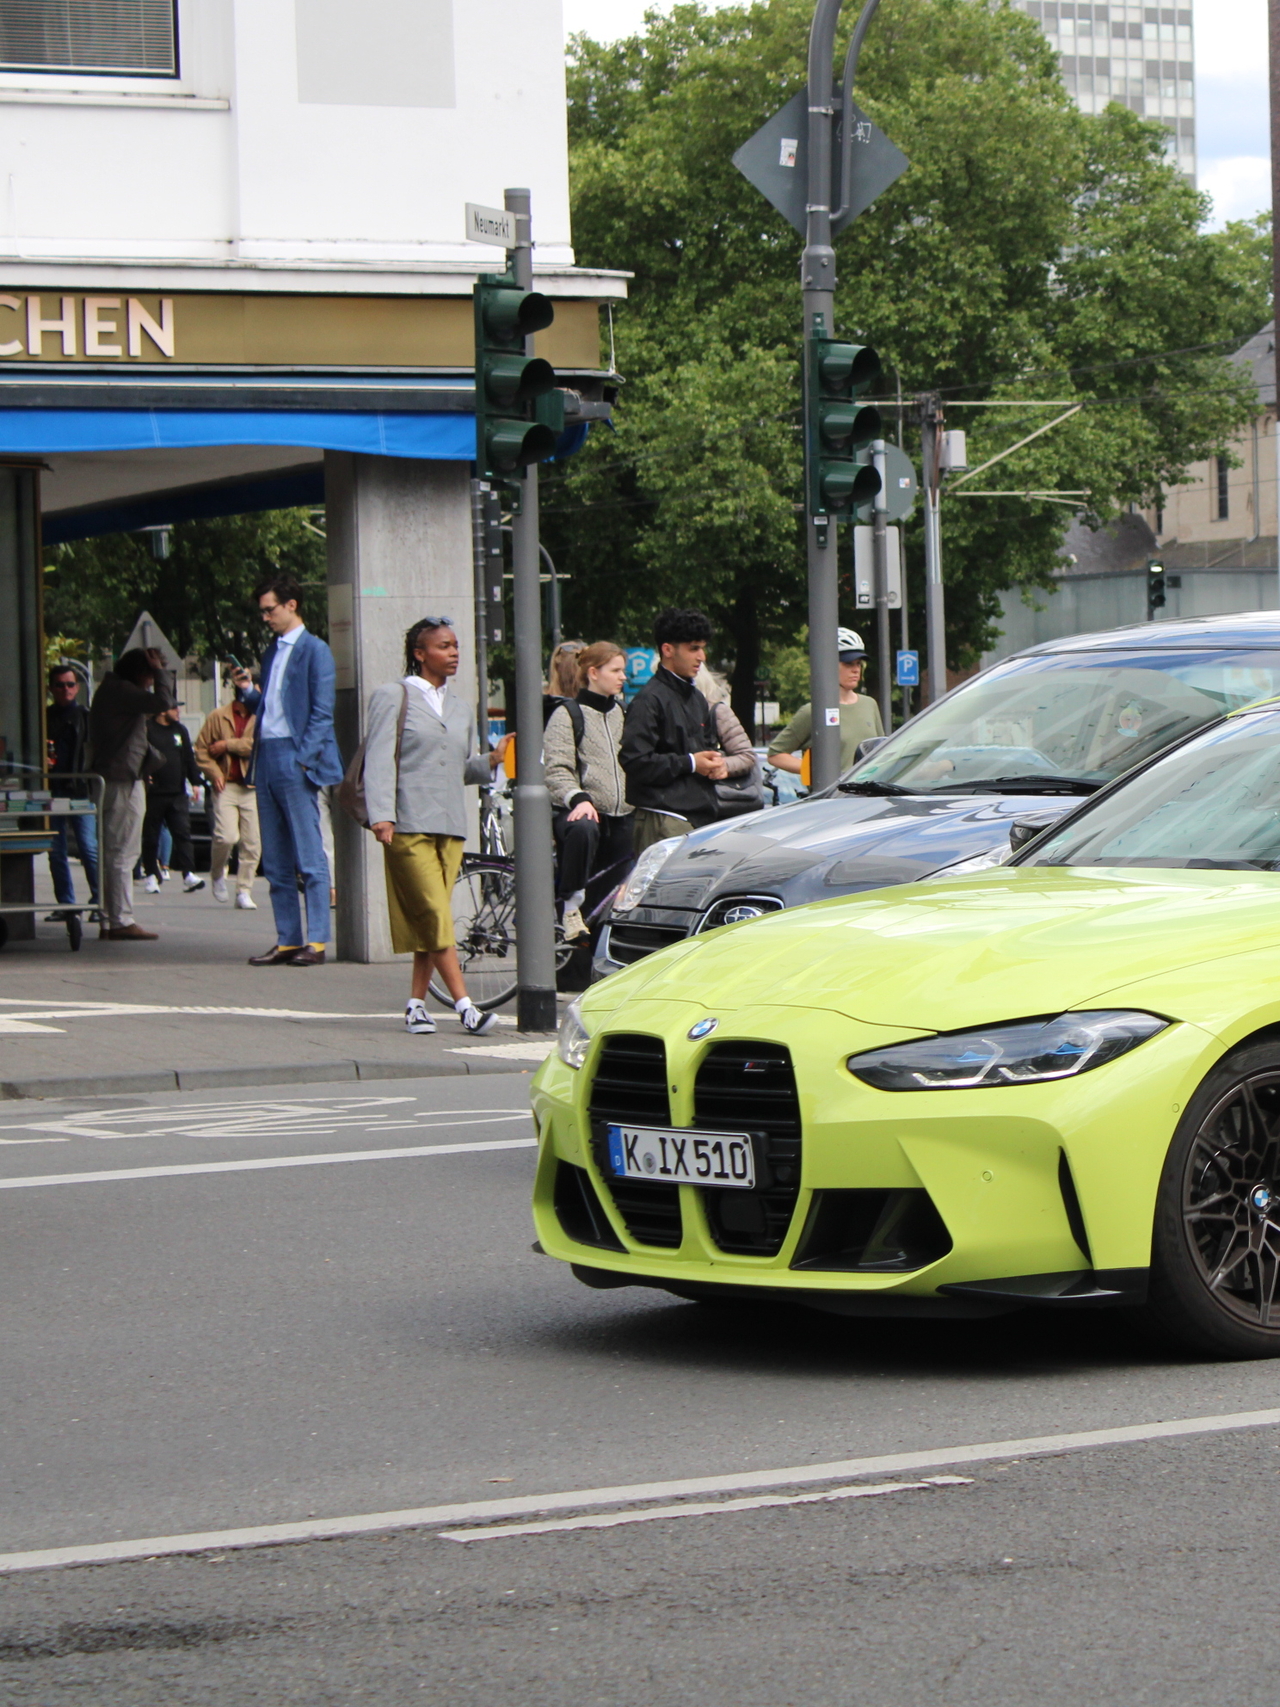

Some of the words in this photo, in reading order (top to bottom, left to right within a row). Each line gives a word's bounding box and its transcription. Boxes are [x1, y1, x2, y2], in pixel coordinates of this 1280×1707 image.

[473, 210, 510, 239] Neumarkt
[624, 1133, 641, 1172] K
[658, 1136, 690, 1176] IX
[693, 1139, 748, 1180] 510
